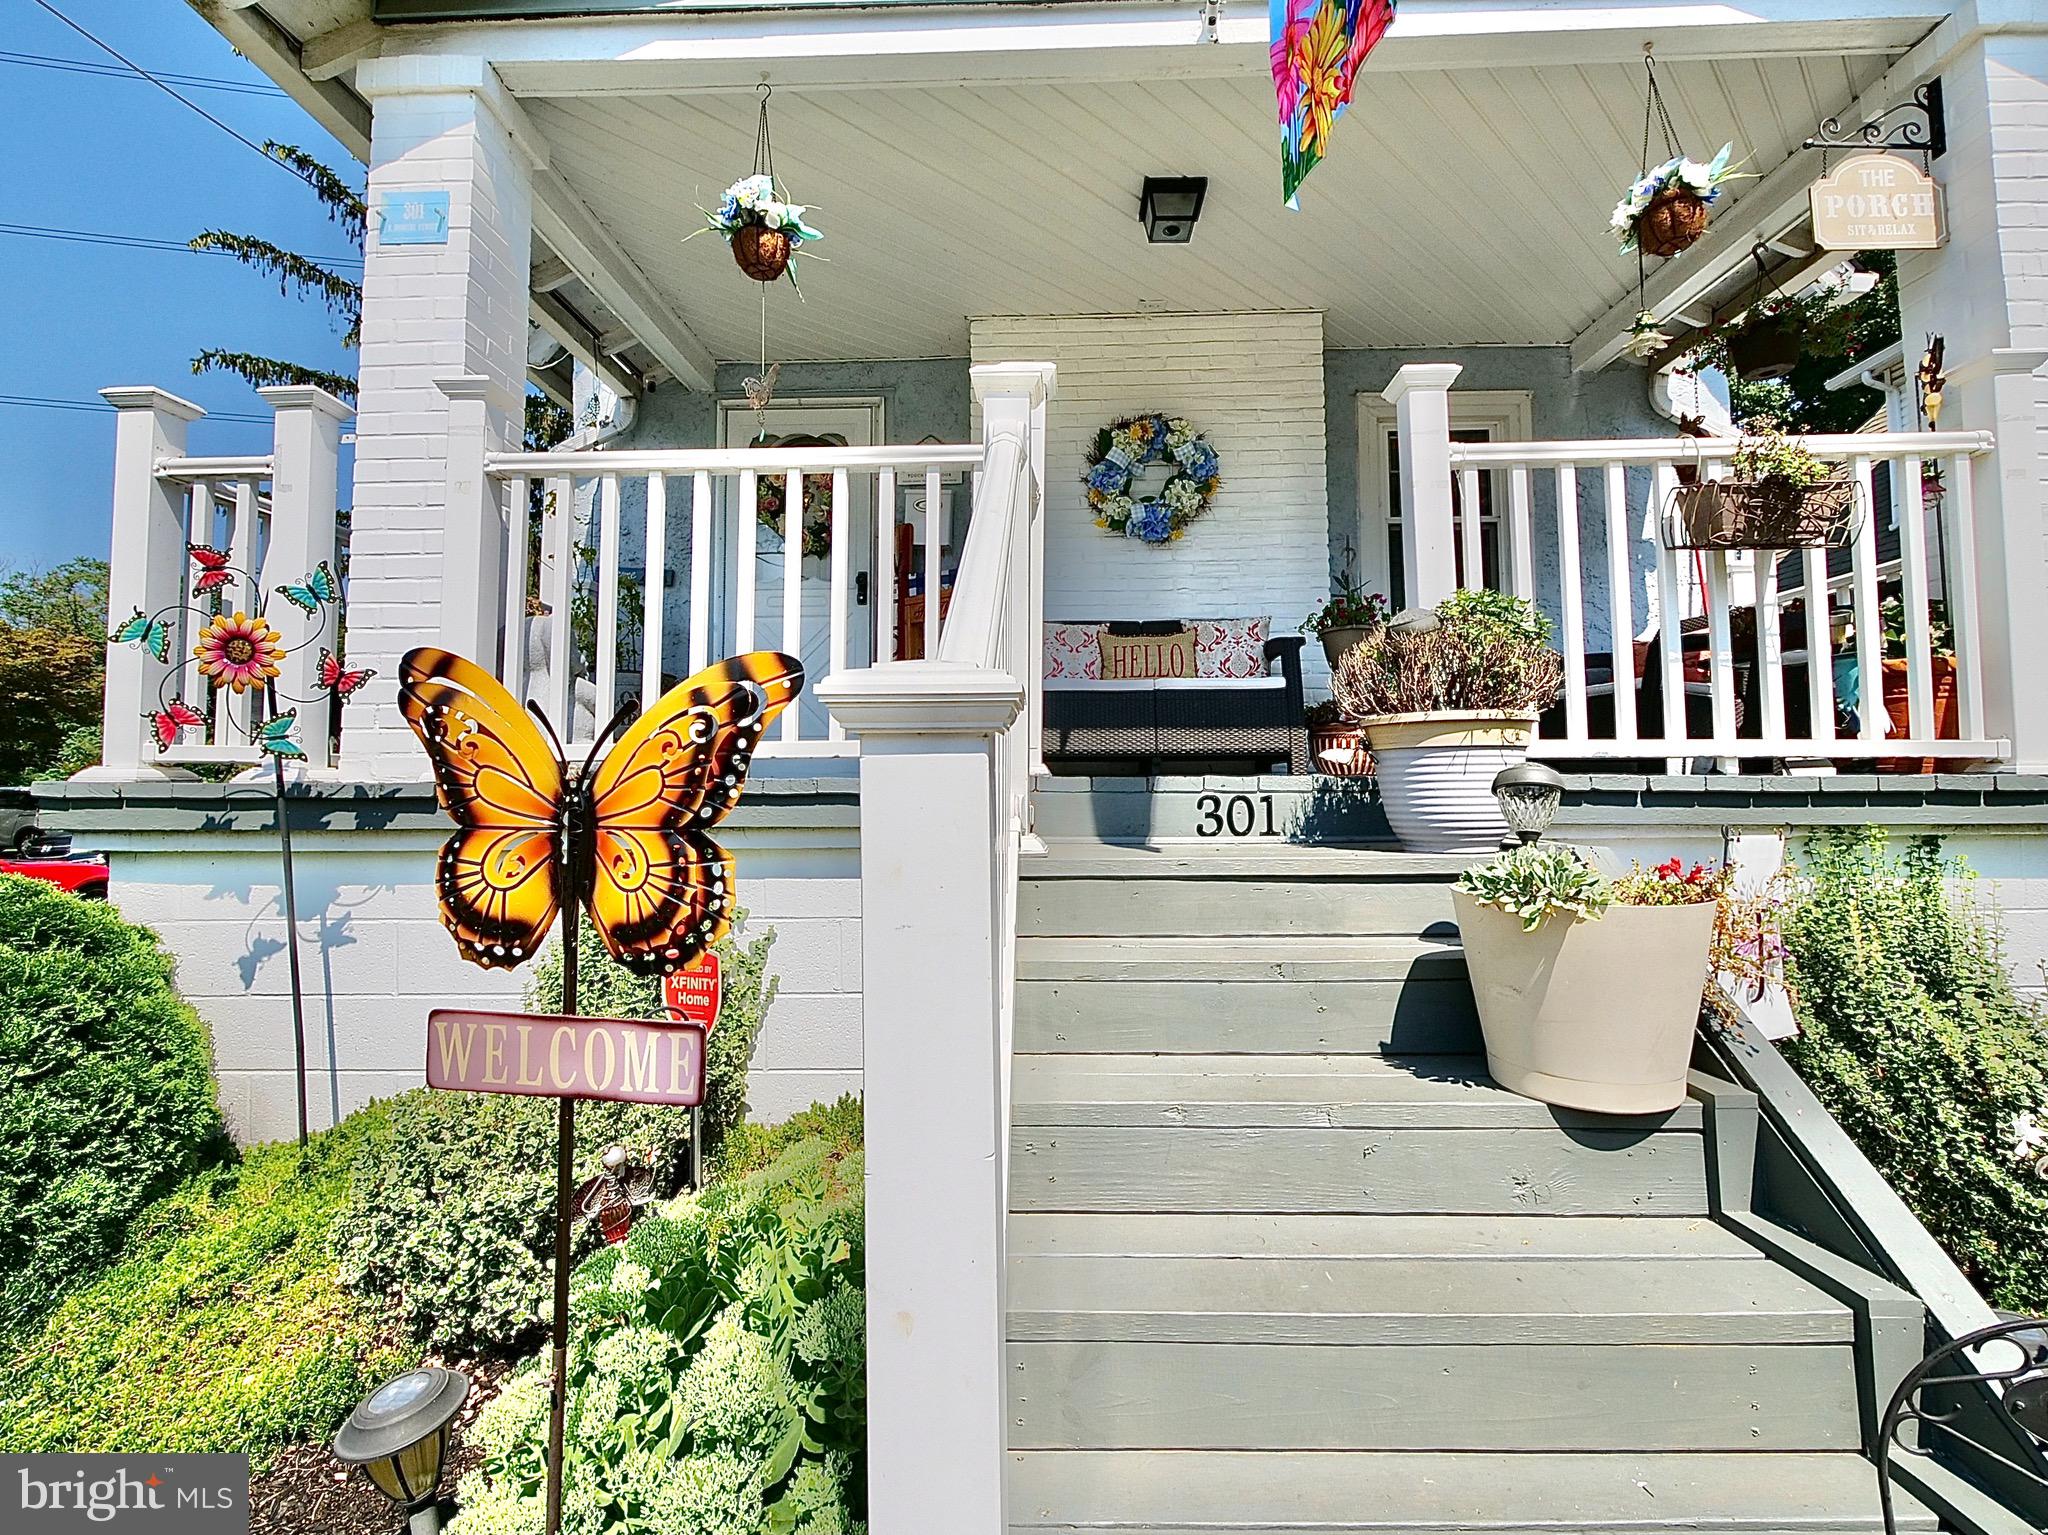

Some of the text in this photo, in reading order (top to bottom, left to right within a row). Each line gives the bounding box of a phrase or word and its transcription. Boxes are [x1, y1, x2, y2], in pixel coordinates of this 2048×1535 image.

[1858, 169, 1896, 187] THE
[1824, 193, 1934, 218] PORCH
[1113, 643, 1185, 679] HELLO
[1196, 795, 1281, 837] 301
[704, 965, 712, 974] BY
[671, 976, 717, 991] XFINITY
[677, 991, 710, 1006] Home
[434, 1021, 695, 1095] WELCOME
